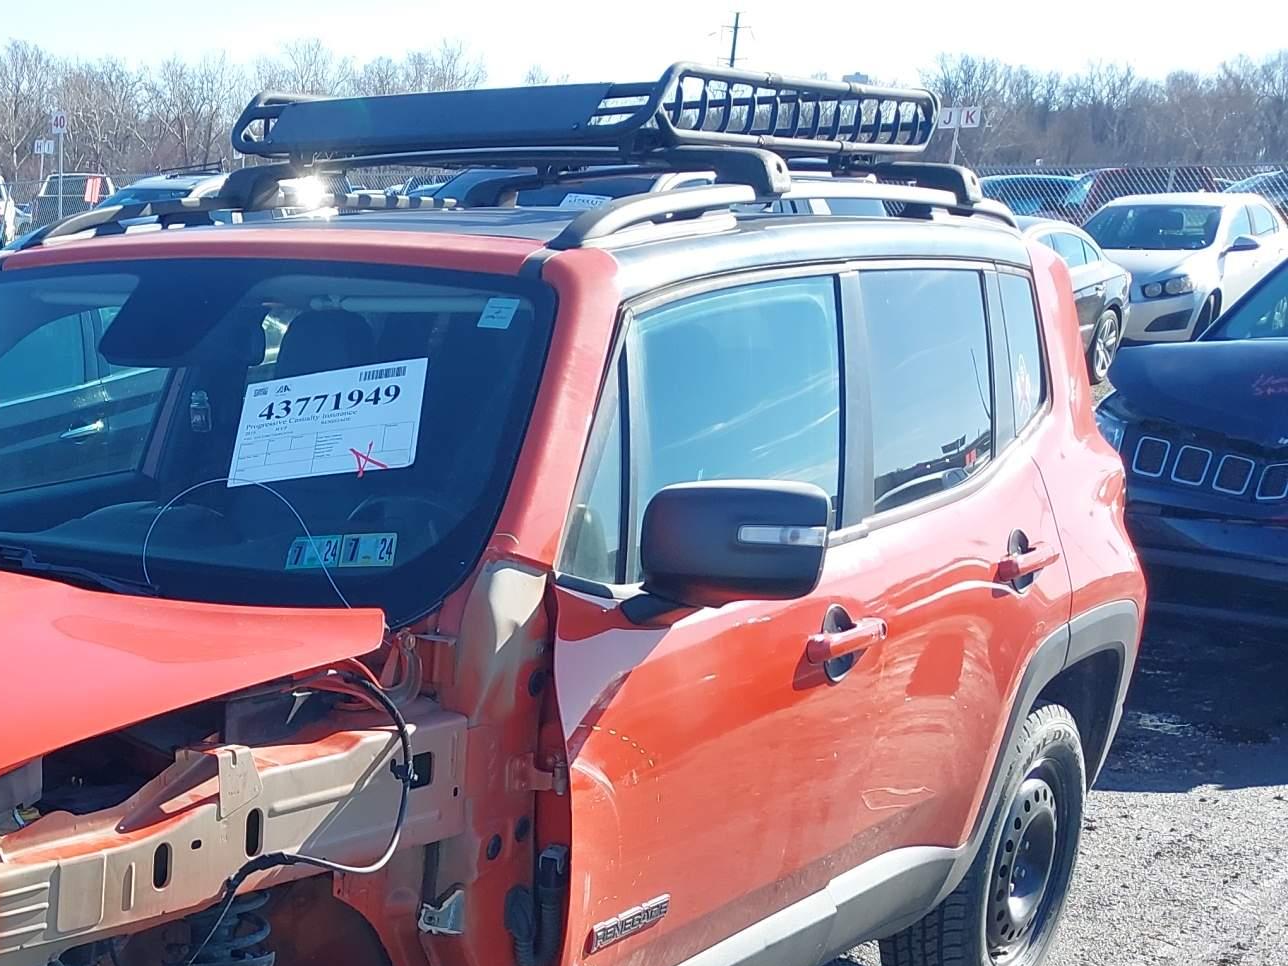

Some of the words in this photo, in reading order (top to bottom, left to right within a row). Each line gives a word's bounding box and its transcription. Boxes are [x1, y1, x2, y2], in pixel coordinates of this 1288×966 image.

[53, 115, 65, 128] 40
[943, 111, 952, 125] J
[965, 110, 976, 124] K
[258, 384, 401, 421] 43771949
[246, 420, 288, 431] Progressive
[294, 545, 304, 565] 7
[324, 540, 339, 562] 24
[349, 538, 360, 561] 7
[378, 537, 394, 561] 24
[593, 896, 669, 950] RENEGADE
